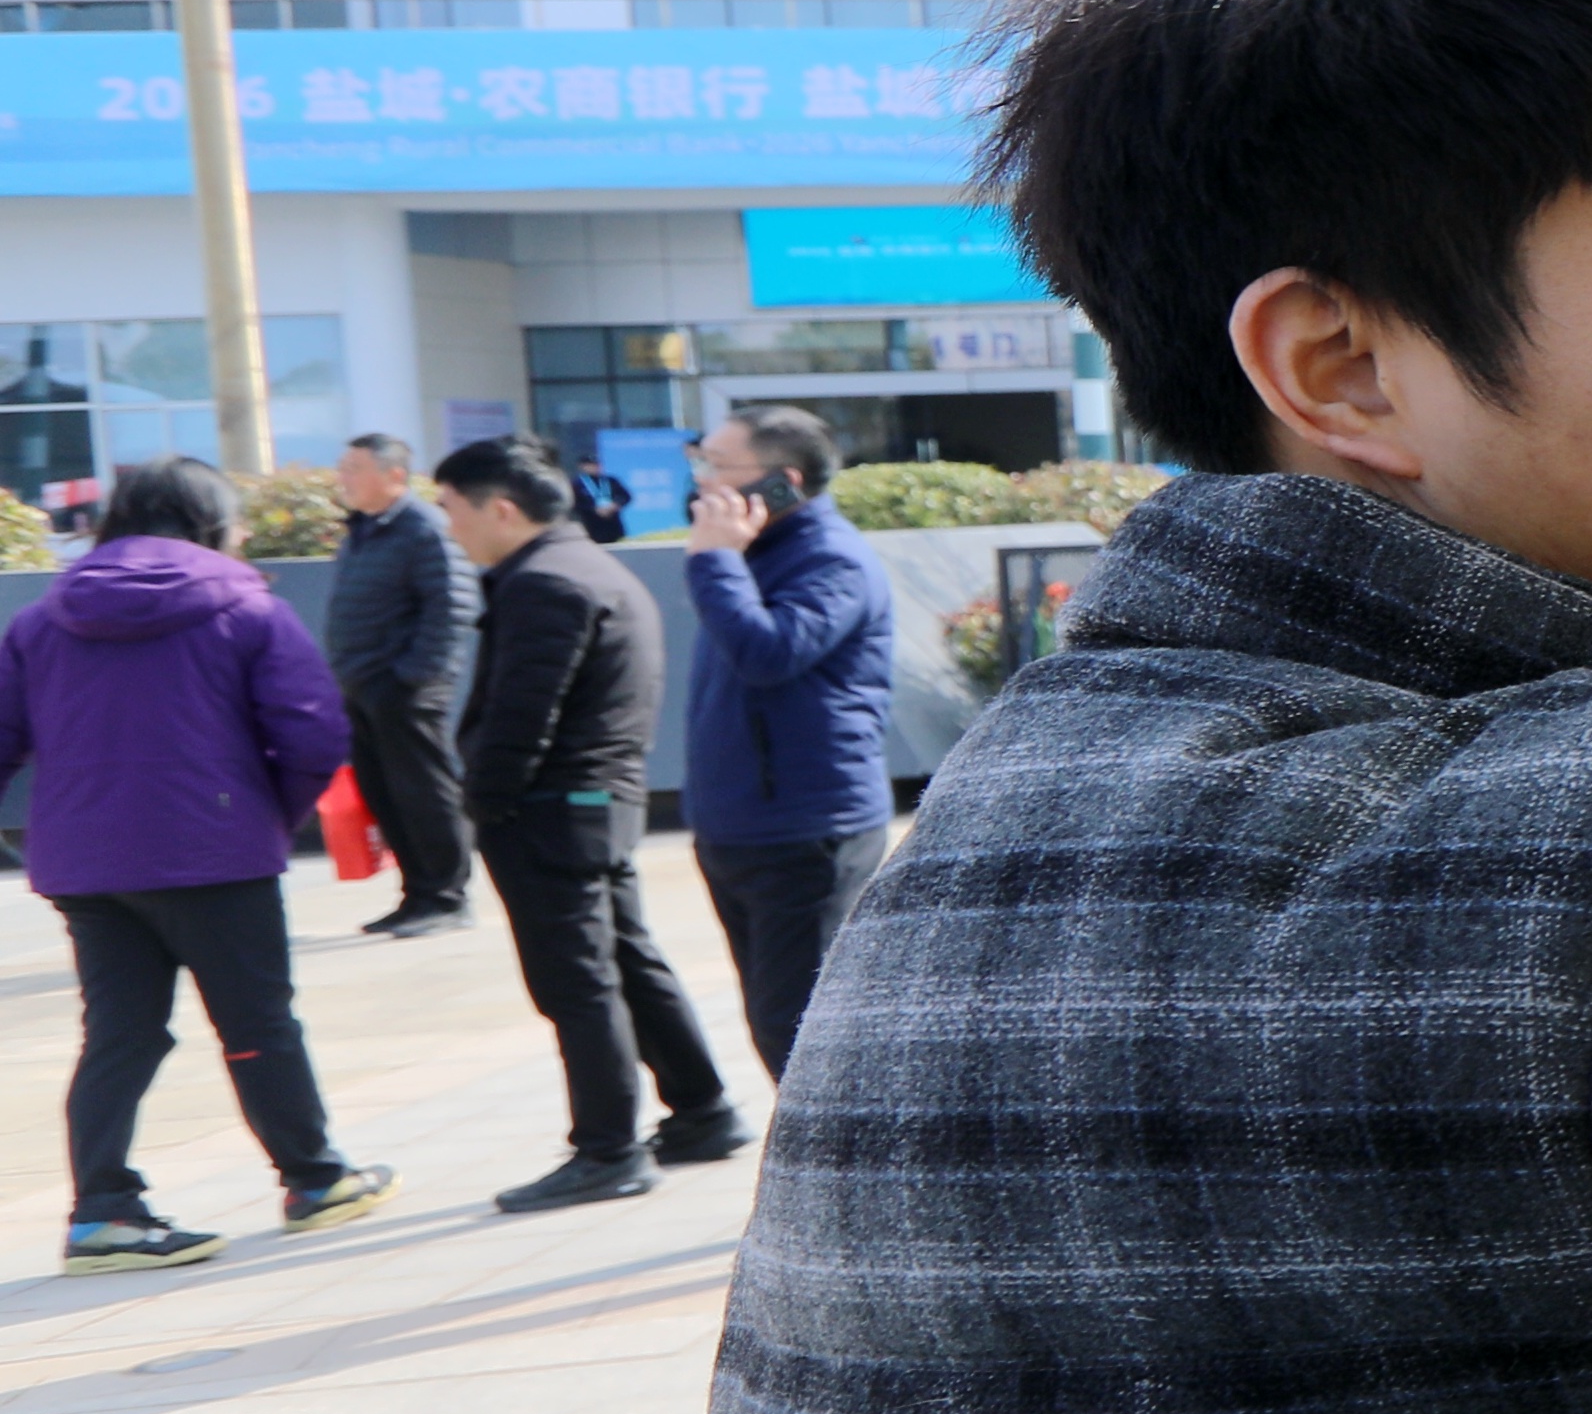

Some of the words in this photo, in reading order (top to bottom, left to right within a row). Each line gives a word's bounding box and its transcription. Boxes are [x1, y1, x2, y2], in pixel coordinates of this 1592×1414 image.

[97, 75, 276, 121] 206
[302, 66, 768, 123] 盐城·农商银行
